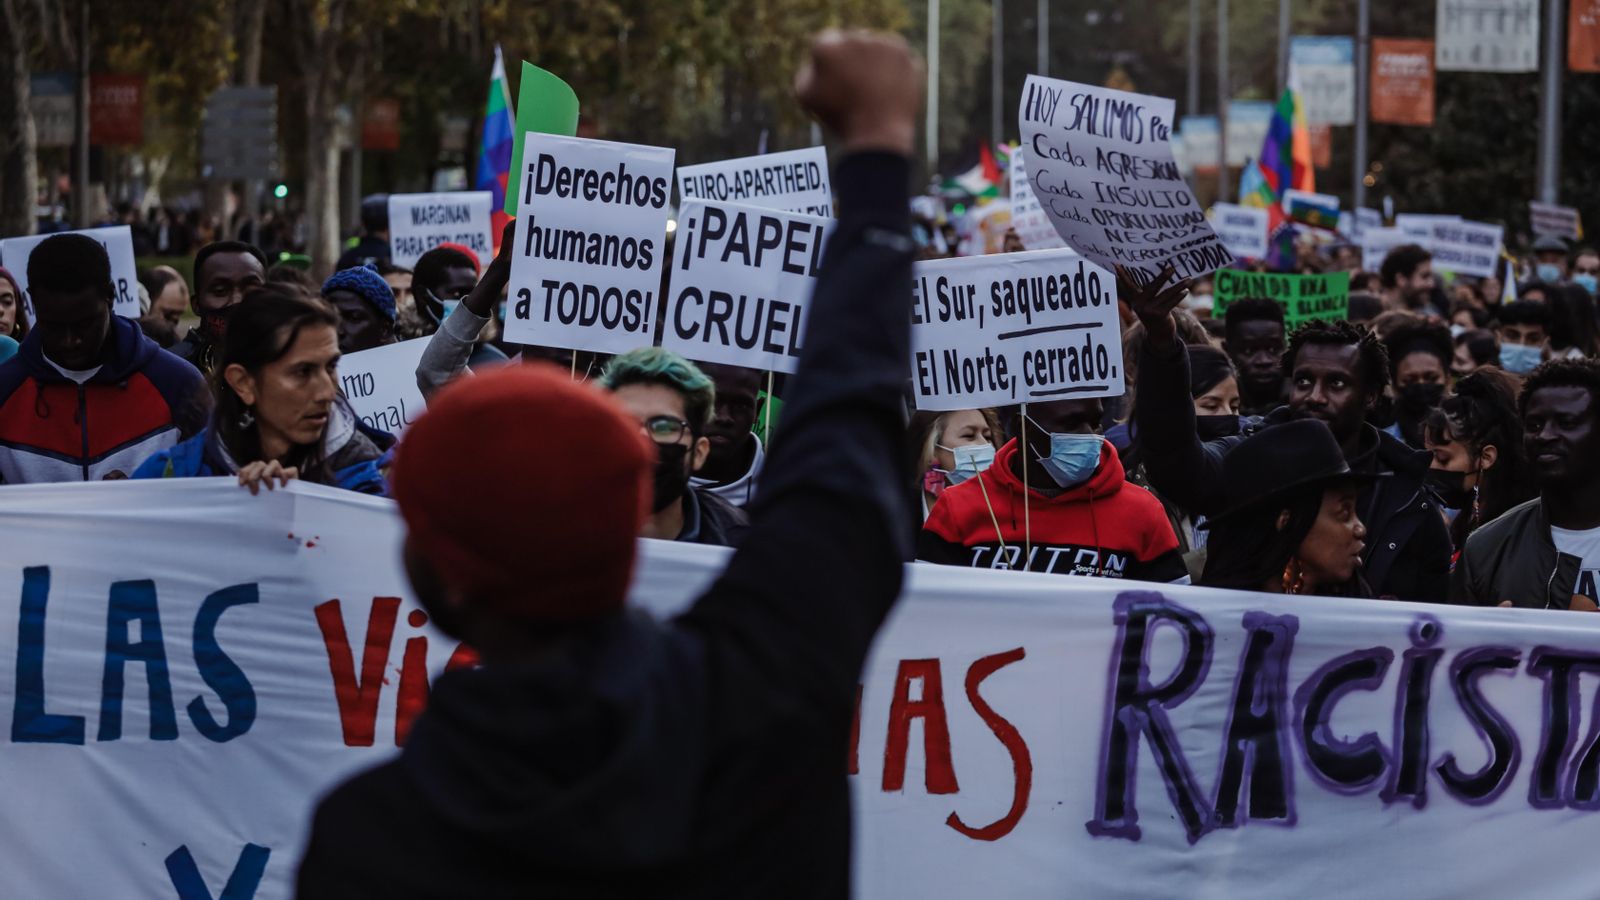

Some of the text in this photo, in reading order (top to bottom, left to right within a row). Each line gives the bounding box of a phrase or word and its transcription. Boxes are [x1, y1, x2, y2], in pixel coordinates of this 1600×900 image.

[1025, 83, 1062, 127] HOY
[1064, 93, 1145, 144] SALIMOS
[524, 153, 667, 209] ¡Derechos
[1091, 181, 1191, 208] INSULTO
[411, 203, 471, 225] MARGINAN
[1091, 207, 1205, 231] OPORTUNIDAD
[1104, 225, 1207, 244] NEGADA
[395, 232, 488, 256] PARA EOTAR.
[524, 215, 654, 271] humanos
[1111, 245, 1170, 262] PUERTA
[515, 279, 652, 333] a TODOS!
[936, 276, 984, 329] Sur,
[991, 261, 1110, 325] saqueado.
[916, 333, 1117, 399] El Norte, cerrado.
[11, 565, 259, 745] LAS
